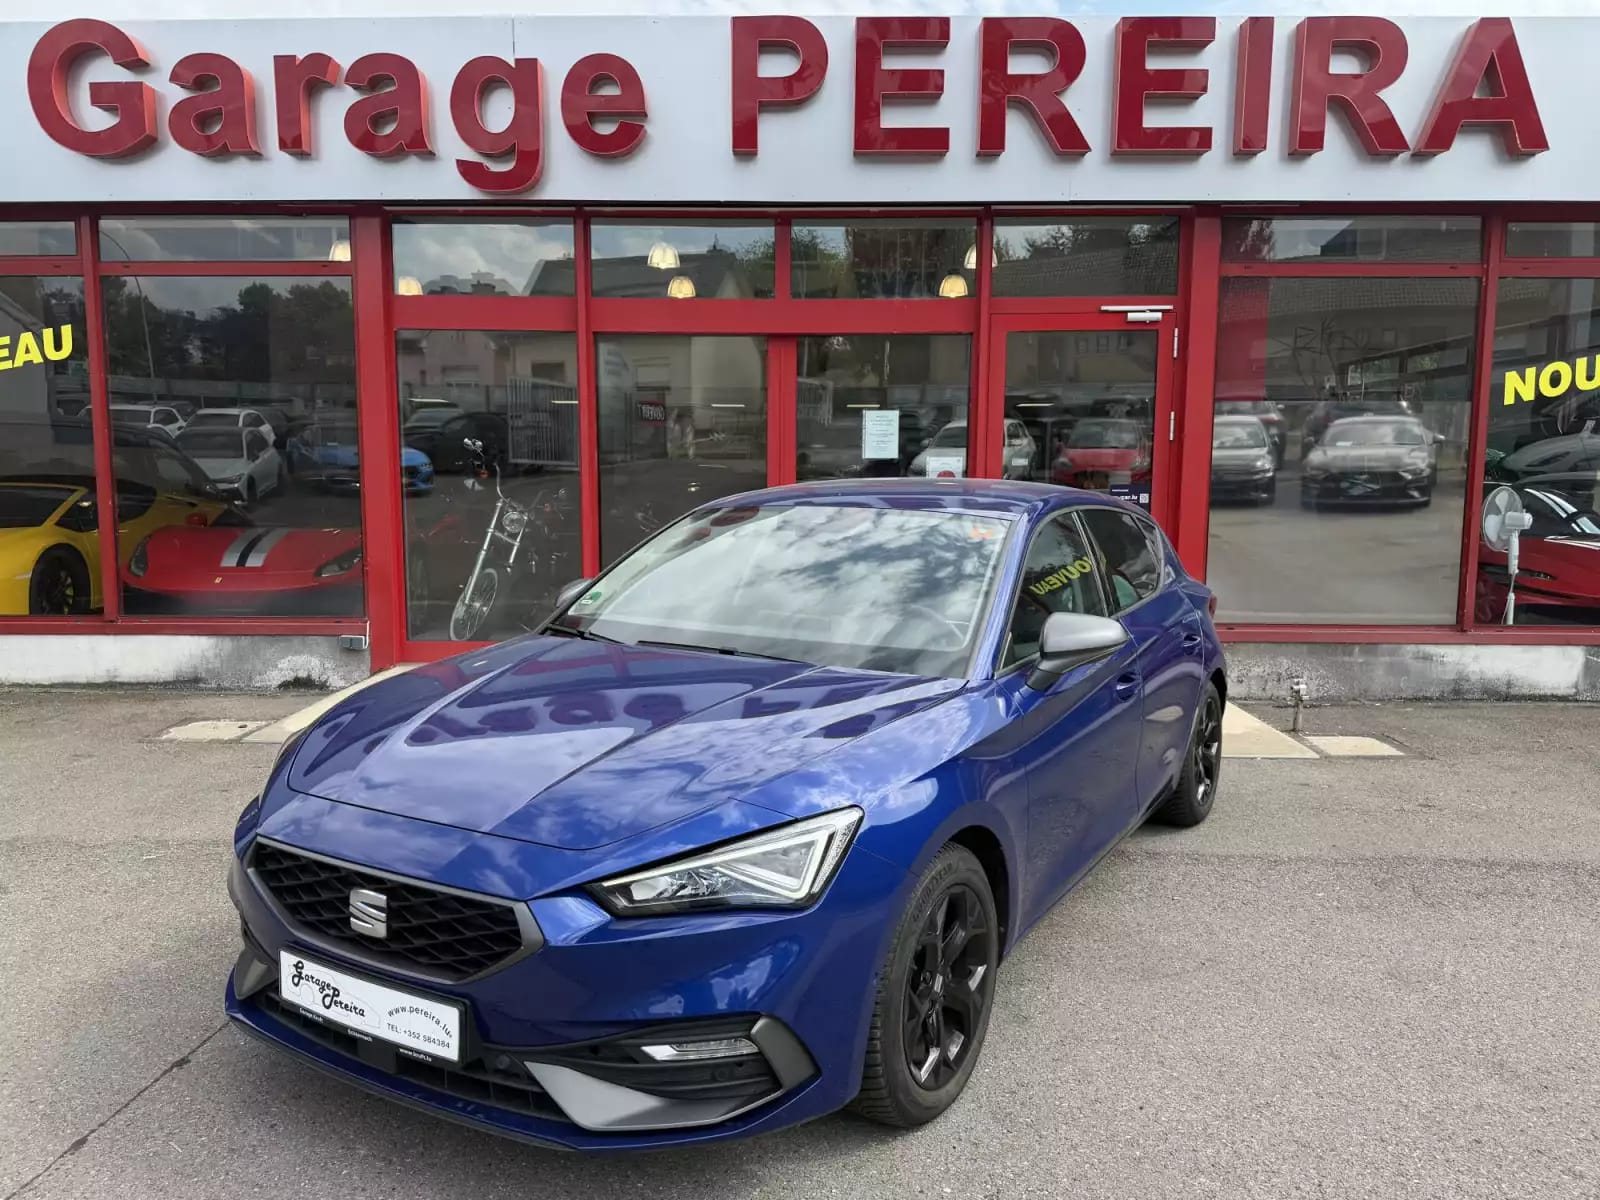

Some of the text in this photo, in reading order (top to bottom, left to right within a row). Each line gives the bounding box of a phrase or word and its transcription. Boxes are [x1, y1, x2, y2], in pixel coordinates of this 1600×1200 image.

[27, 15, 1550, 194] Garage PEREIRA
[1503, 354, 1600, 406] NOU
[292, 960, 332, 994] Garage
[322, 986, 366, 1017] Pereira
